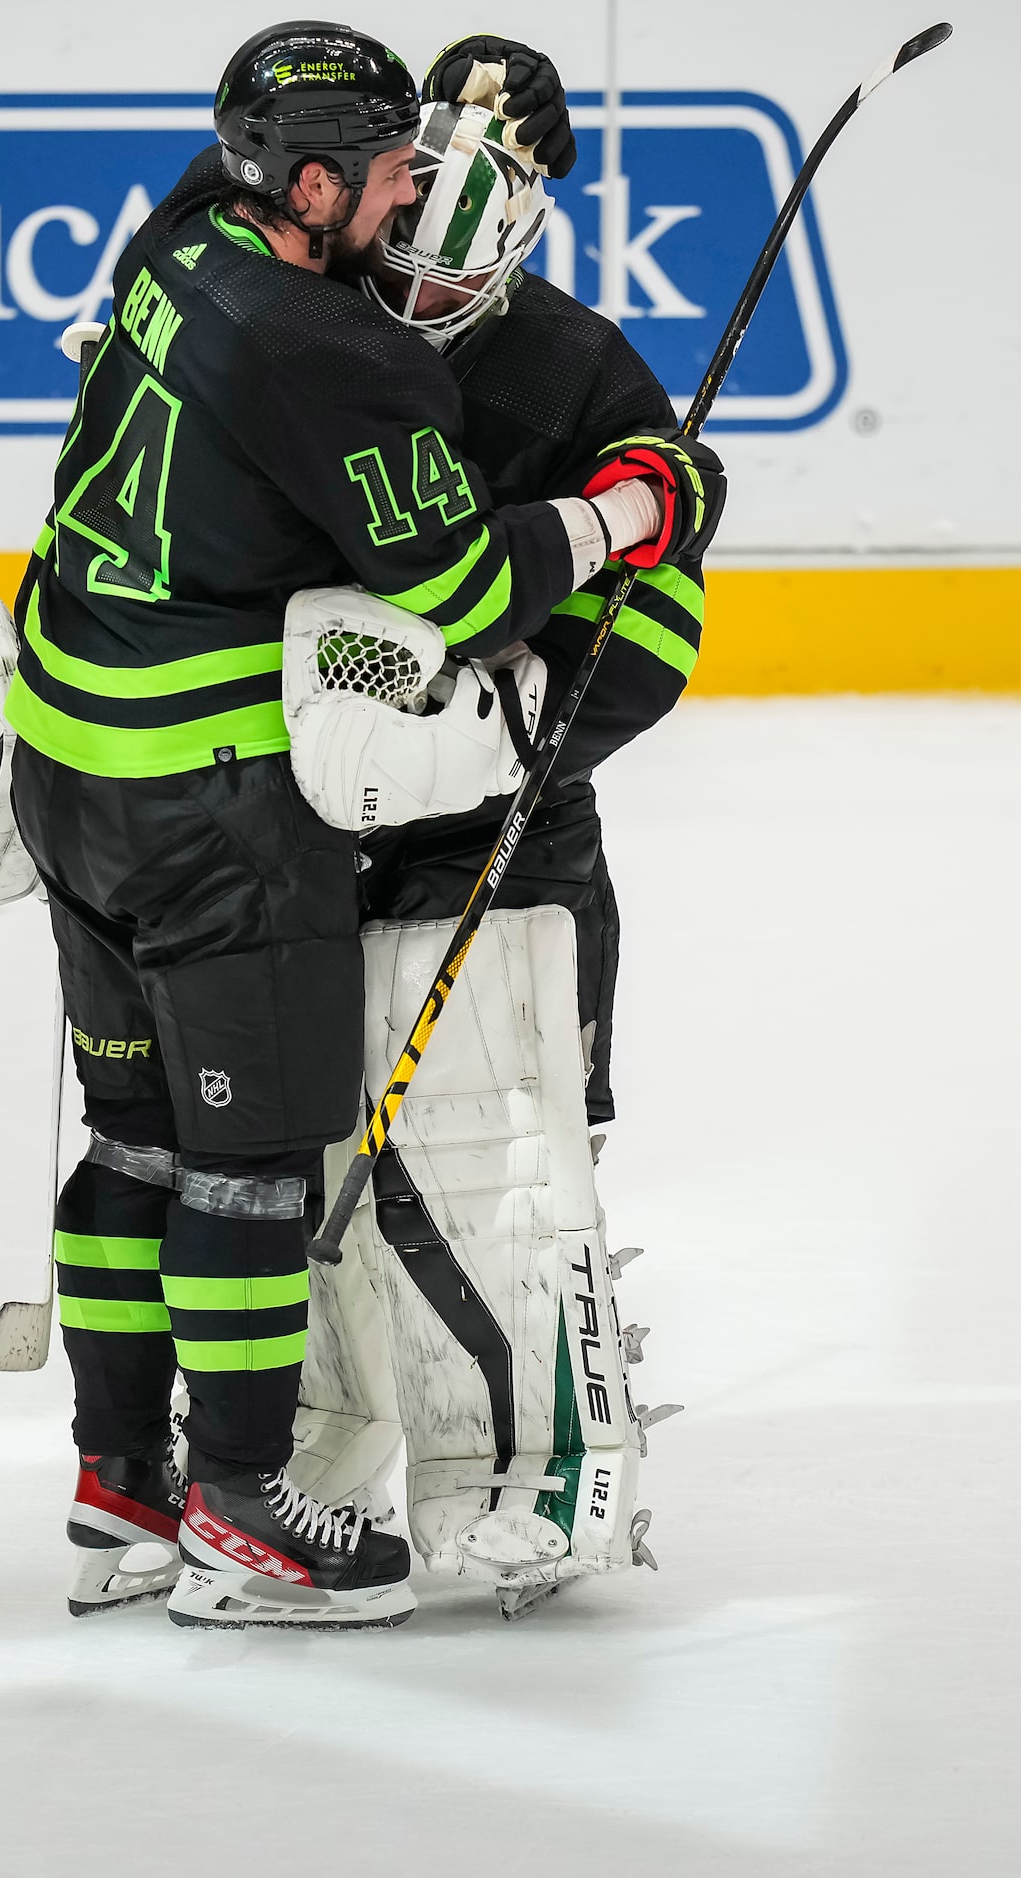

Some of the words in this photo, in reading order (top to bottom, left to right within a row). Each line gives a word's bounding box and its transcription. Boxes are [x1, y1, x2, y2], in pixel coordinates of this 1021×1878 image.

[300, 62, 344, 72] ENERGY
[301, 72, 356, 82] TRANSFER
[171, 249, 198, 271] adidas
[120, 266, 184, 376] BENN
[54, 318, 183, 602] 4
[343, 426, 478, 547] 14
[590, 620, 611, 656] VAPOR
[549, 720, 567, 747] BENN
[362, 787, 379, 822] L12.2
[486, 811, 526, 889] BAUER
[73, 1026, 152, 1060] BAUER
[207, 1079, 225, 1098] NHL
[571, 1243, 612, 1425] TRUE
[167, 1492, 185, 1510] CC
[589, 1467, 611, 1520] L12.2
[187, 1506, 306, 1585] CCM
